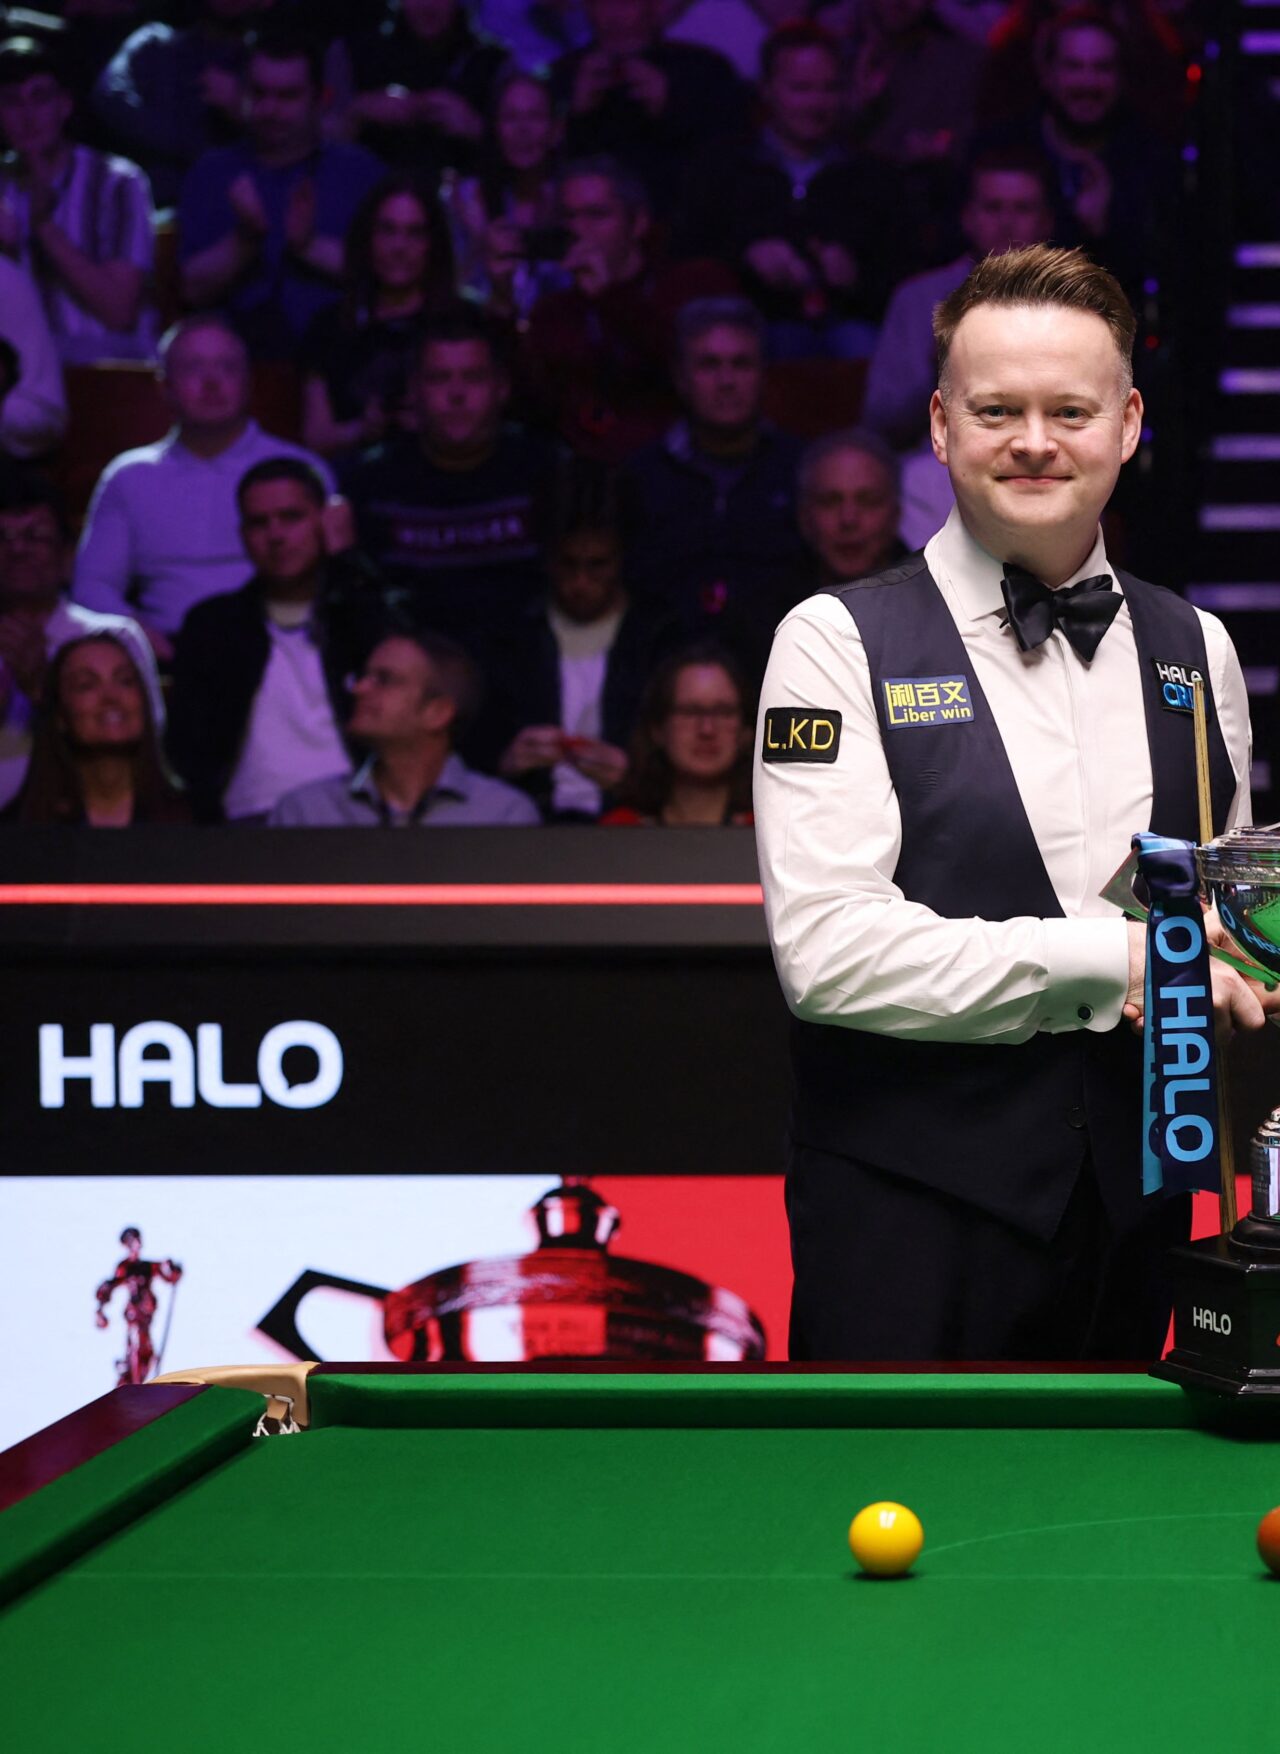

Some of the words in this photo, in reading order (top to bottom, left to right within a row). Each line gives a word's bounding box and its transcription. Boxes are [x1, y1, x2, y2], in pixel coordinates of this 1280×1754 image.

[890, 681, 967, 707] 利百文
[1163, 682, 1195, 709] CR
[940, 705, 971, 720] win
[766, 717, 835, 751] L.KD
[38, 1020, 344, 1109] HALO
[1159, 984, 1214, 1163] HALO
[1193, 1306, 1232, 1336] HALO
